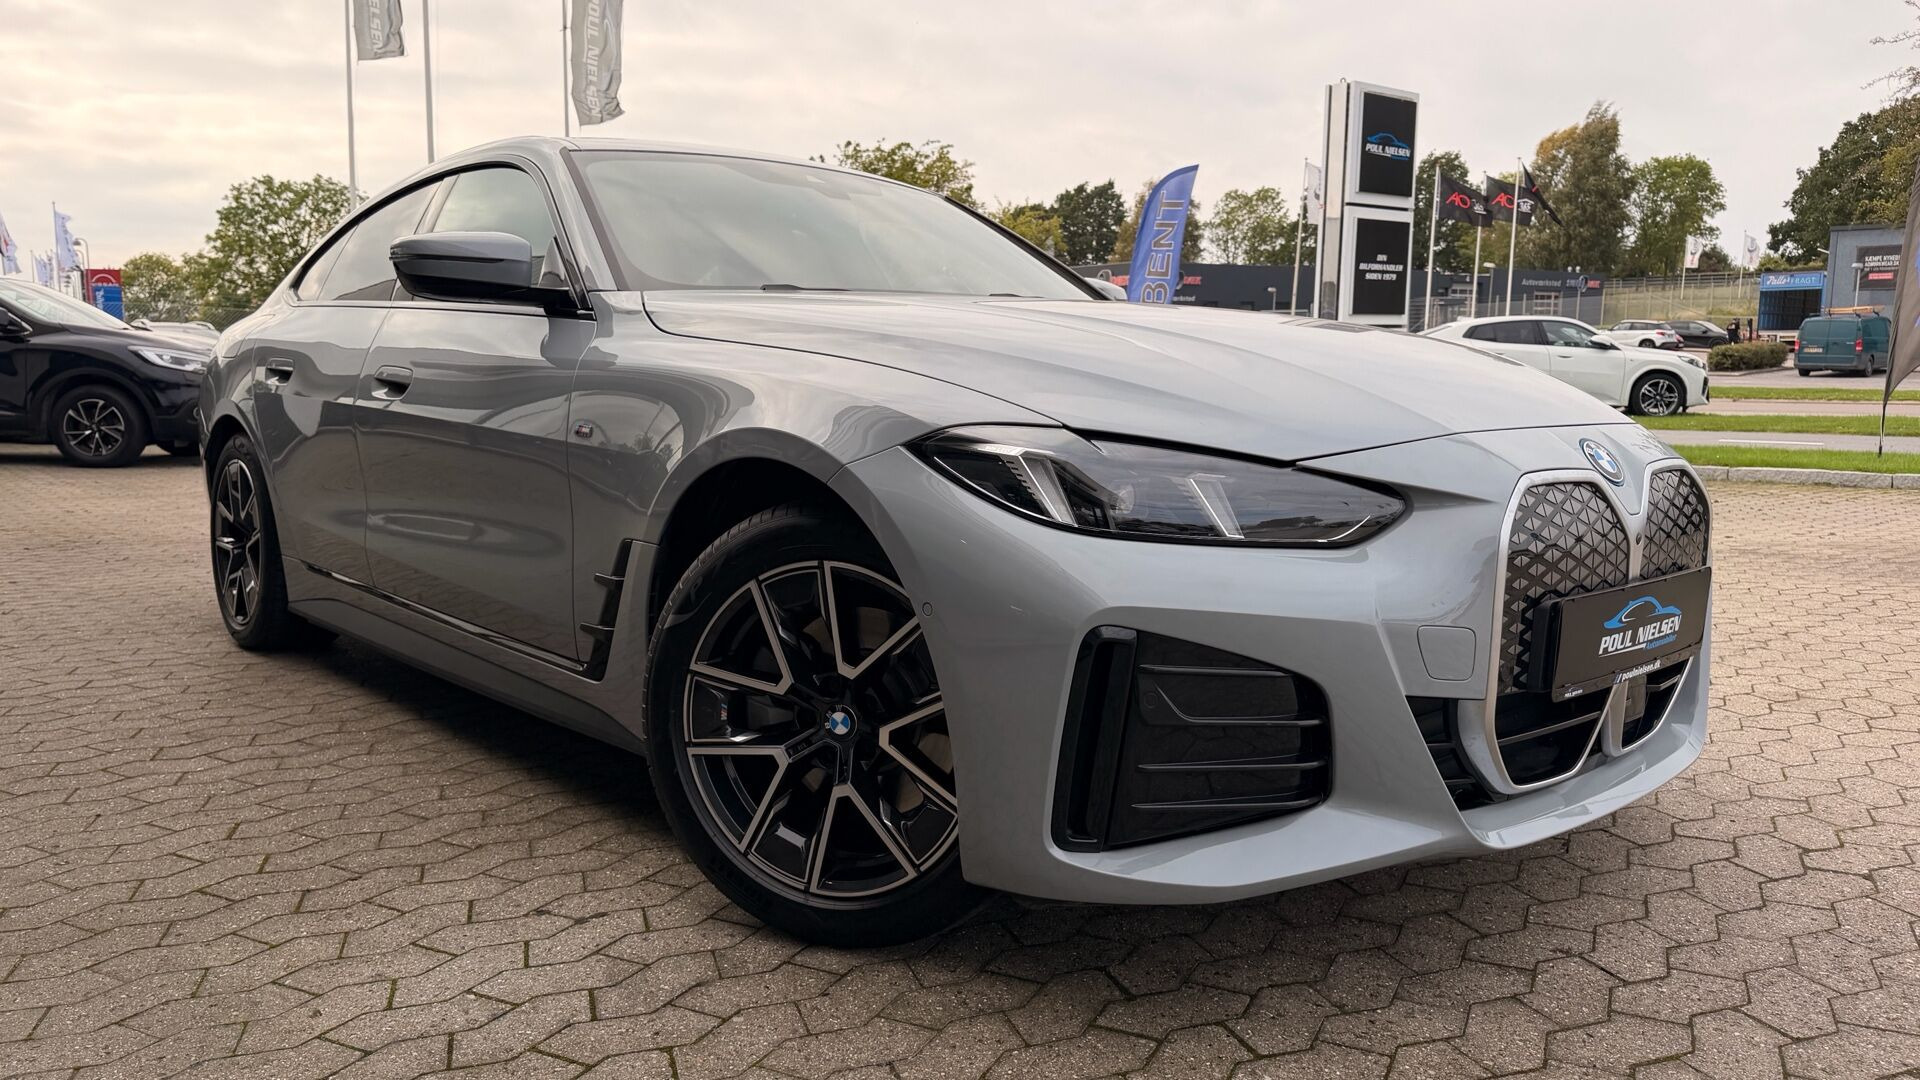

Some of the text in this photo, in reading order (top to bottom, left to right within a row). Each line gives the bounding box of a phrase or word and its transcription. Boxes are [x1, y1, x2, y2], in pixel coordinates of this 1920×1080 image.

[586, 44, 602, 117] NIELSEN
[1366, 143, 1411, 157] POUL NIELSEN
[1446, 191, 1470, 208] AO
[1598, 614, 1682, 655] POUL NIELSEN
[1621, 660, 1661, 682] poulnielsen.dk
